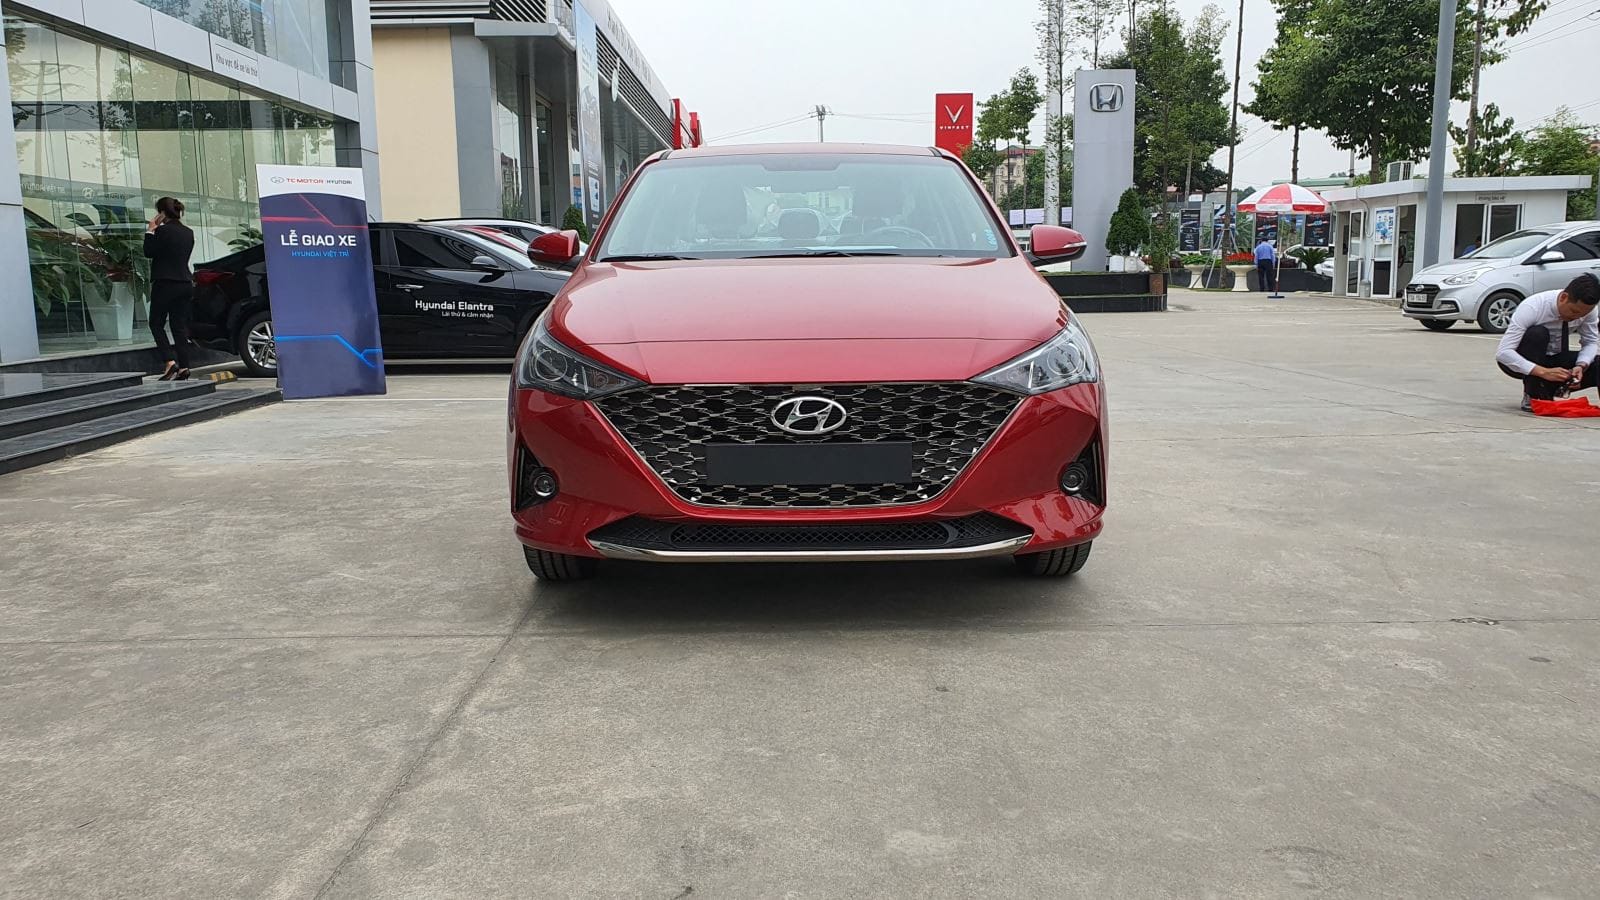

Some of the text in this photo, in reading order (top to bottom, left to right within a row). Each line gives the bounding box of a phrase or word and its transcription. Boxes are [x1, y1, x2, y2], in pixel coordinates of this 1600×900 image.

[280, 230, 357, 247] LỄ GIAO XE
[322, 250, 337, 258] VIỆT
[338, 249, 350, 257] TRÌ
[415, 299, 494, 311] Hyundai Elantra
